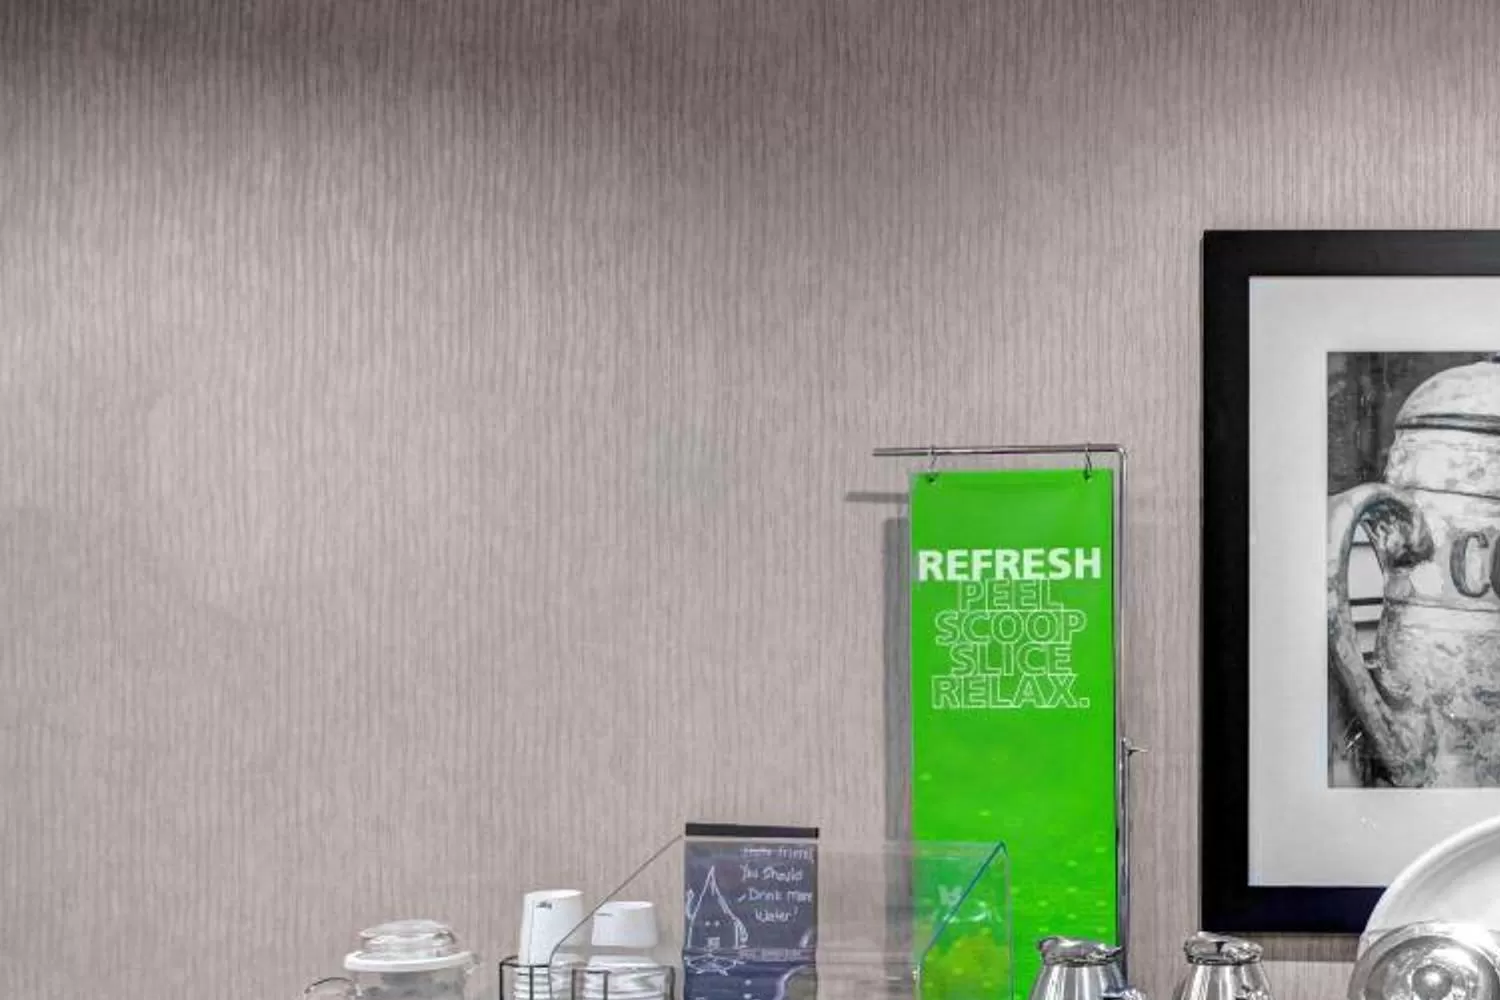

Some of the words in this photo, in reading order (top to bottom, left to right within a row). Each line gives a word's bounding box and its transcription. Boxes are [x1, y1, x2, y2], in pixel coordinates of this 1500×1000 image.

[918, 547, 1101, 582] REFRESH
[958, 578, 1065, 612] PEEL
[935, 608, 1088, 646] SCOOP
[951, 642, 1073, 678] SLICE
[931, 673, 1091, 709] RELAX.
